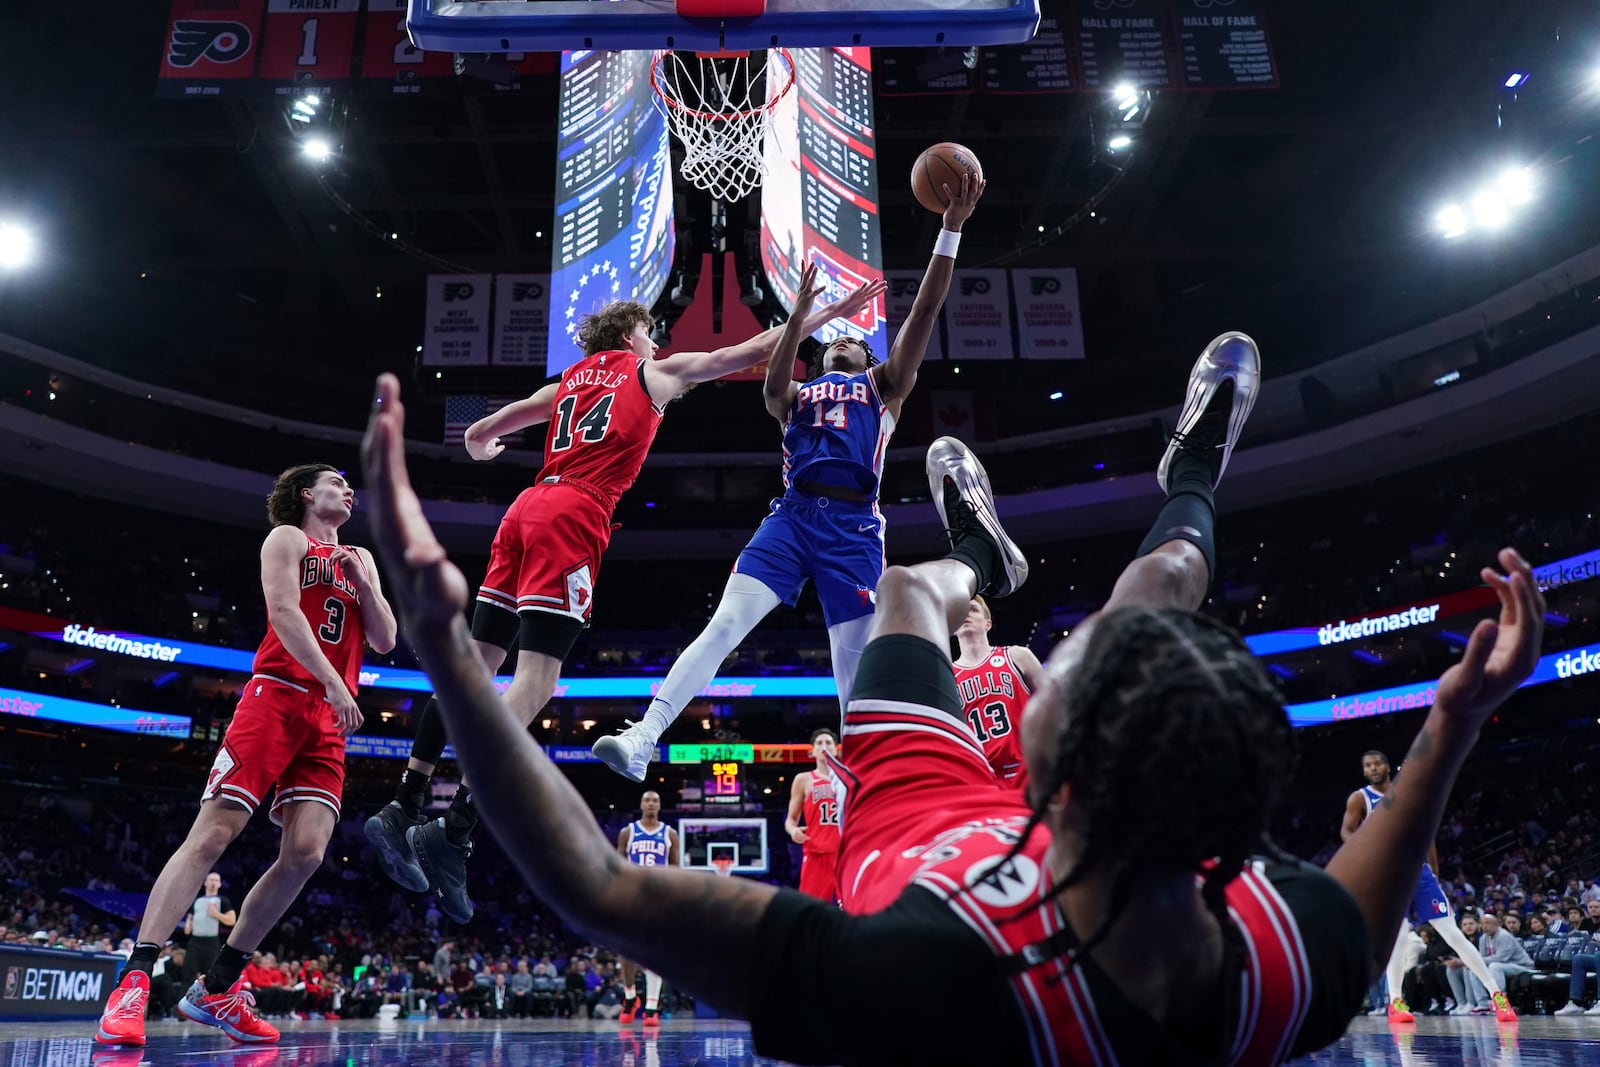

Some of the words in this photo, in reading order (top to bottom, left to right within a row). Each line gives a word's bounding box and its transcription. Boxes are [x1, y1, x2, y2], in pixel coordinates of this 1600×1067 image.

[1082, 18, 1108, 28] HALL
[1110, 18, 1123, 28] OF
[1125, 18, 1155, 28] FAME
[1183, 16, 1210, 26] HALL
[1211, 16, 1225, 26] OF
[1227, 16, 1257, 26] FAME
[298, 18, 318, 65] 1
[565, 368, 628, 392] BUZELIS
[796, 381, 870, 414] PHILA
[551, 391, 616, 453] 14
[811, 402, 848, 429] 14
[318, 596, 346, 645] 3
[1318, 604, 1440, 646] ticketmaster
[63, 624, 182, 662] ticketmaster
[967, 700, 1012, 744] 13
[712, 762, 738, 776] 9:40
[716, 775, 736, 794] 19
[819, 801, 838, 825] 12
[631, 840, 665, 857] PHILA
[639, 853, 656, 866] 16
[22, 967, 103, 1001] BETMGM
